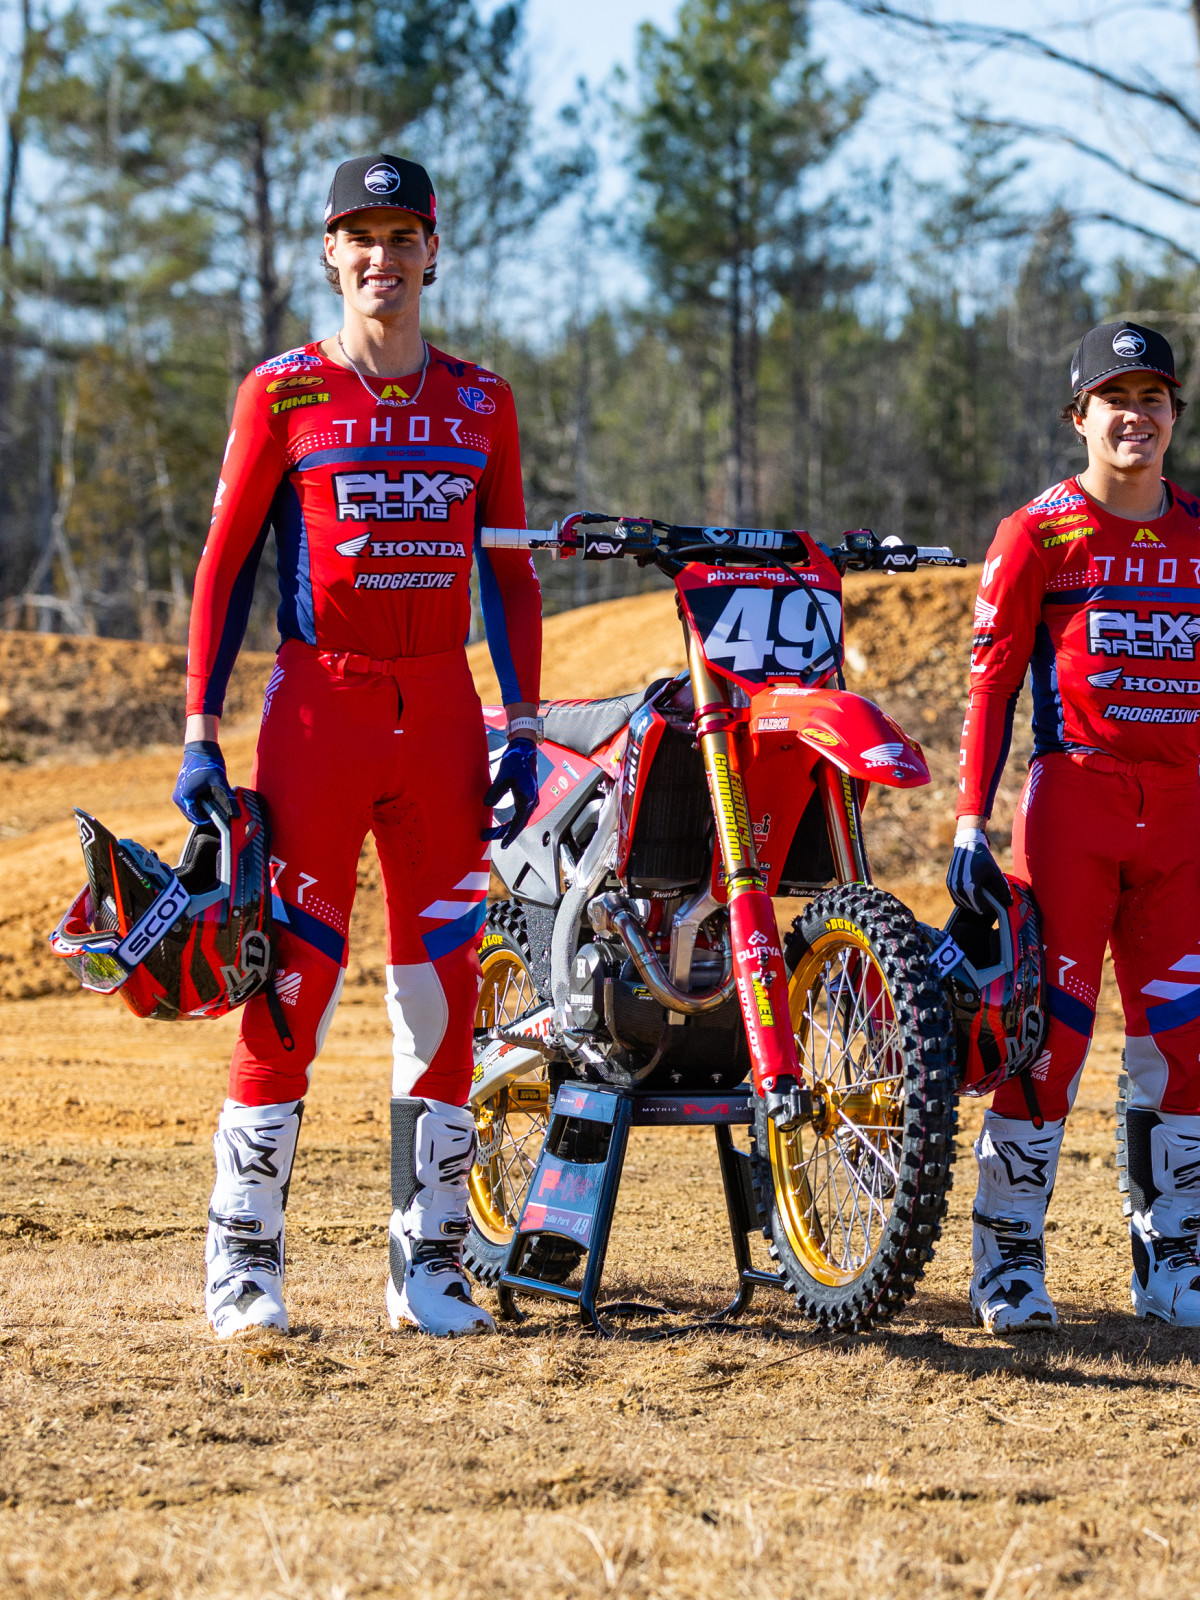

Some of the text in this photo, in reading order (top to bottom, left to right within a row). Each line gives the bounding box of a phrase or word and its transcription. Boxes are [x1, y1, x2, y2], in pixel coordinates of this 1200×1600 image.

[271, 392, 330, 414] TAMER
[457, 386, 485, 411] VP
[335, 473, 451, 503] PHX
[339, 503, 448, 519] RACING
[1042, 527, 1095, 548] TAMER
[370, 542, 467, 557] HONDA
[586, 541, 623, 554] ASV
[883, 554, 917, 565] ASV
[928, 557, 955, 565] ASV
[703, 587, 842, 673] 49
[1089, 611, 1192, 643] PHX
[1090, 638, 1194, 659] RACING
[865, 760, 919, 772] HONDA
[789, 888, 809, 896] Twin
[830, 917, 871, 947] DUNLOP
[280, 994, 298, 1007] X68
[736, 976, 762, 1060] DUNLOP
[1030, 1071, 1047, 1082] X68
[557, 1216, 570, 1227] Park
[572, 1217, 590, 1235] 49
